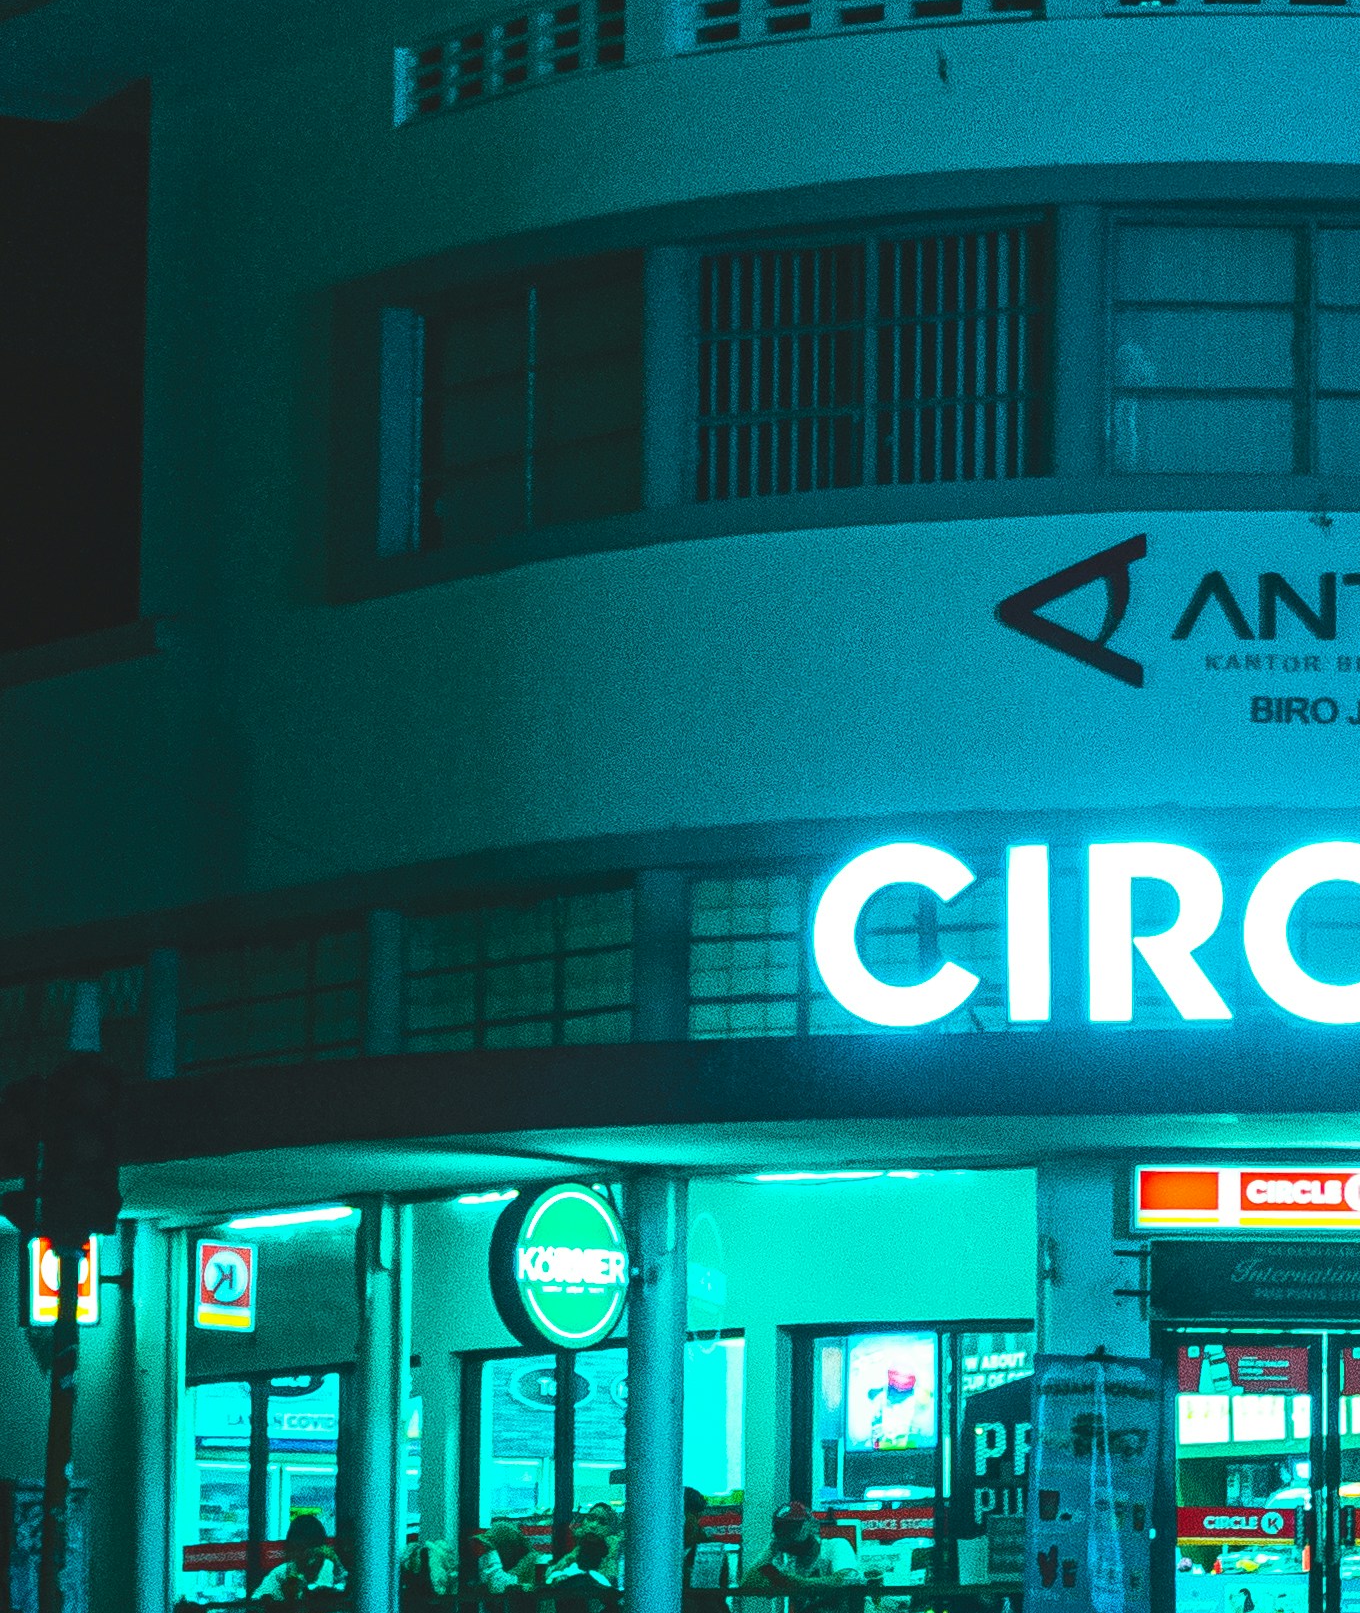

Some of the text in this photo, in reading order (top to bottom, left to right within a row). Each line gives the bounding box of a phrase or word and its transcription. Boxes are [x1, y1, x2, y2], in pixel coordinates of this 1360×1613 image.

[1205, 654, 1321, 674] KANTOR
[1250, 695, 1339, 726] BIRO
[1246, 1179, 1343, 1204] CIRCLE
[980, 1351, 1026, 1370] ABOUT
[1203, 1515, 1258, 1530] CIRCLE
